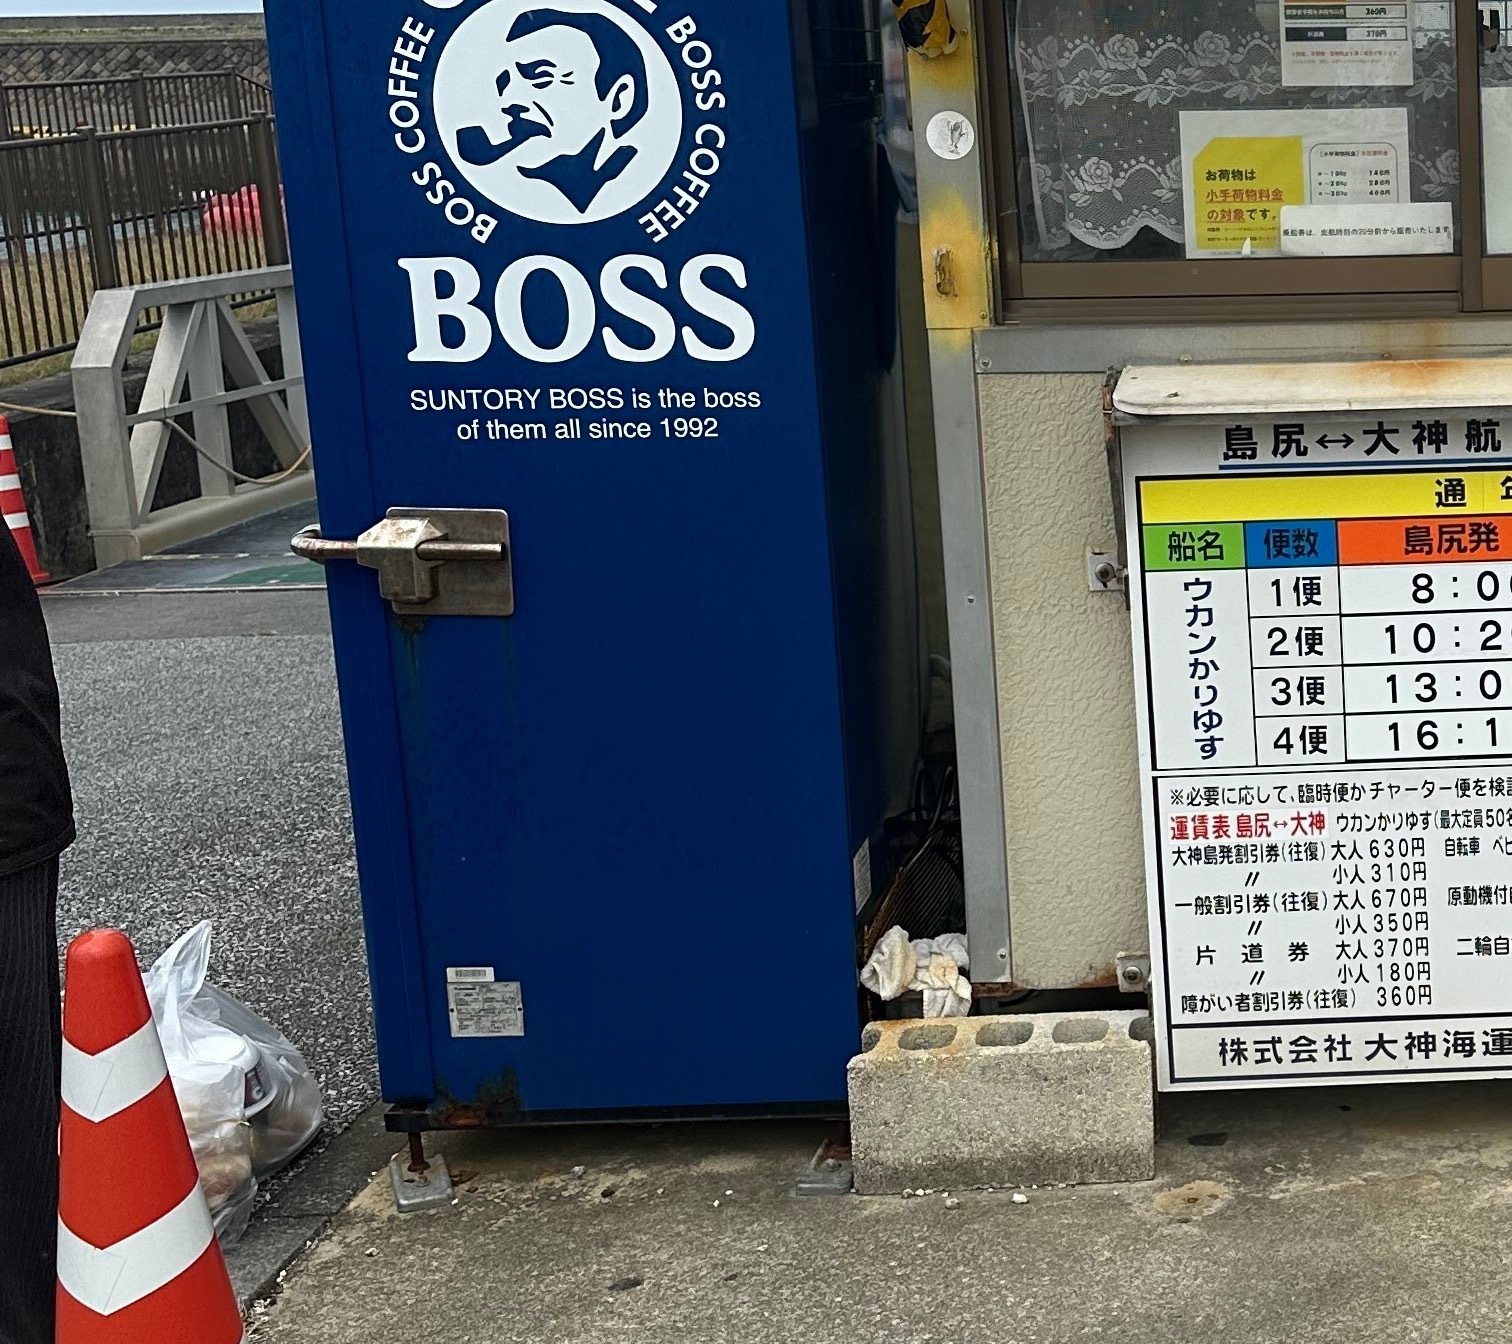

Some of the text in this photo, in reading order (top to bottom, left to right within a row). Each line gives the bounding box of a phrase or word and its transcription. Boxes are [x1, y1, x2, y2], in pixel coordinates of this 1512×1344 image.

[387, 15, 500, 245] BOSS COFFEE
[637, 14, 727, 244] BOSS COFFEE
[1204, 167, 1257, 183] お荷物は
[397, 252, 756, 365] BOSS
[409, 387, 762, 412] SUNTORY BOSS is the boss
[456, 416, 720, 441] of them all since 1992
[1221, 423, 1311, 462] 島尻
[1166, 528, 1226, 564] 船名
[1262, 524, 1320, 558] 便数
[1402, 522, 1501, 556] 島尻発
[1269, 574, 1323, 609] 1便
[1266, 625, 1325, 658] 2便
[1181, 576, 1225, 762] ウカンかりゆす
[1269, 674, 1327, 708] 3便
[1271, 724, 1329, 757] 4便
[1170, 809, 1326, 841] 運賃表 島尻 大神
[1171, 841, 1326, 867] 大神島発割引券(往復)
[1330, 839, 1364, 861] 大人
[1368, 837, 1425, 858] 630円
[1443, 836, 1481, 858] 自転車
[1332, 864, 1365, 885] 小人
[1370, 861, 1428, 882] 310円
[1174, 891, 1329, 917] 一般割引券(往復)
[1332, 889, 1366, 912] 大人
[1371, 887, 1428, 909] 670円
[1334, 913, 1368, 936] 小人
[1373, 911, 1430, 933] 350円
[1335, 939, 1369, 961] 大人
[1373, 936, 1430, 959] 370円
[1337, 963, 1370, 985] 小人
[1376, 961, 1432, 983] 180円
[1180, 984, 1433, 1015] 障がい者割引券(往復) 360円
[1218, 1033, 1354, 1068] 株式会社
